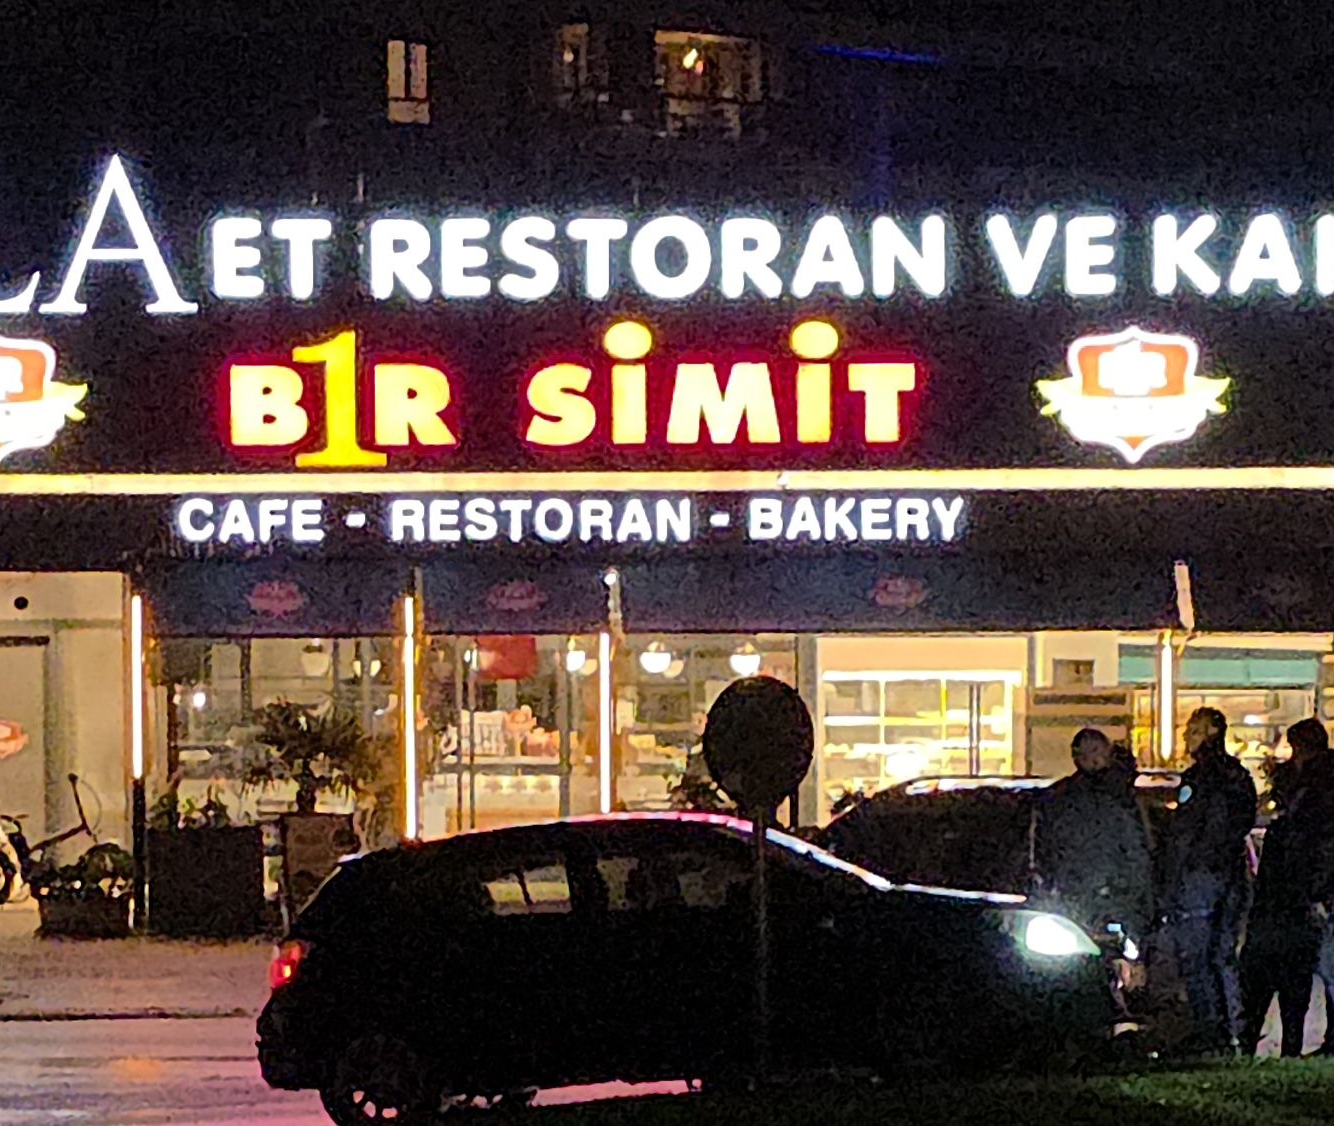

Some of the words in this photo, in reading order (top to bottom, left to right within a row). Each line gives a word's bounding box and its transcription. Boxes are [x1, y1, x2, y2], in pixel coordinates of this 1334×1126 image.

[210, 215, 333, 301] ET
[367, 212, 946, 302] RESTORAN
[985, 212, 1118, 299] VE
[177, 498, 326, 543] CAFE
[388, 497, 692, 543] RESTORAN
[748, 496, 965, 542] BAKERY
